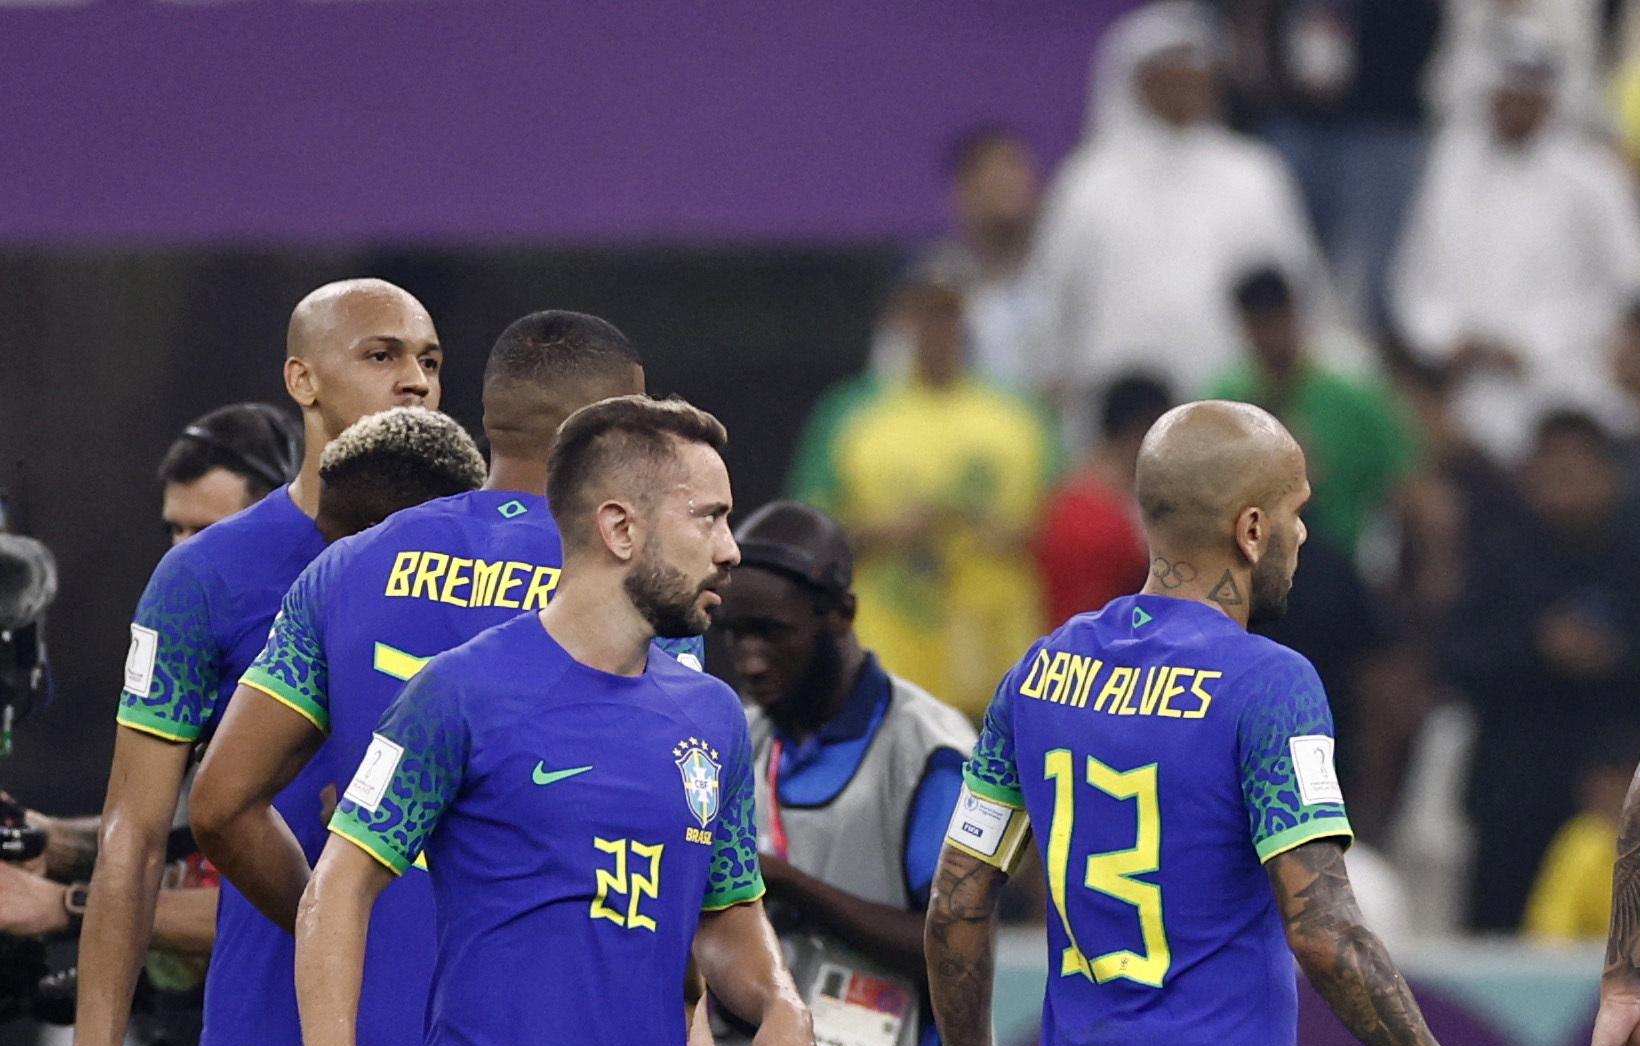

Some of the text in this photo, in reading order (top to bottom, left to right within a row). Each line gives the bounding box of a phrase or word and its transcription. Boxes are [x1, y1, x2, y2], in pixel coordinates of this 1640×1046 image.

[384, 551, 562, 611] BREMER
[1019, 648, 1223, 719] DANI ALVES
[694, 779, 709, 789] CBF
[685, 827, 713, 845] BRASIL
[1044, 748, 1171, 988] 13
[590, 836, 664, 932] 22
